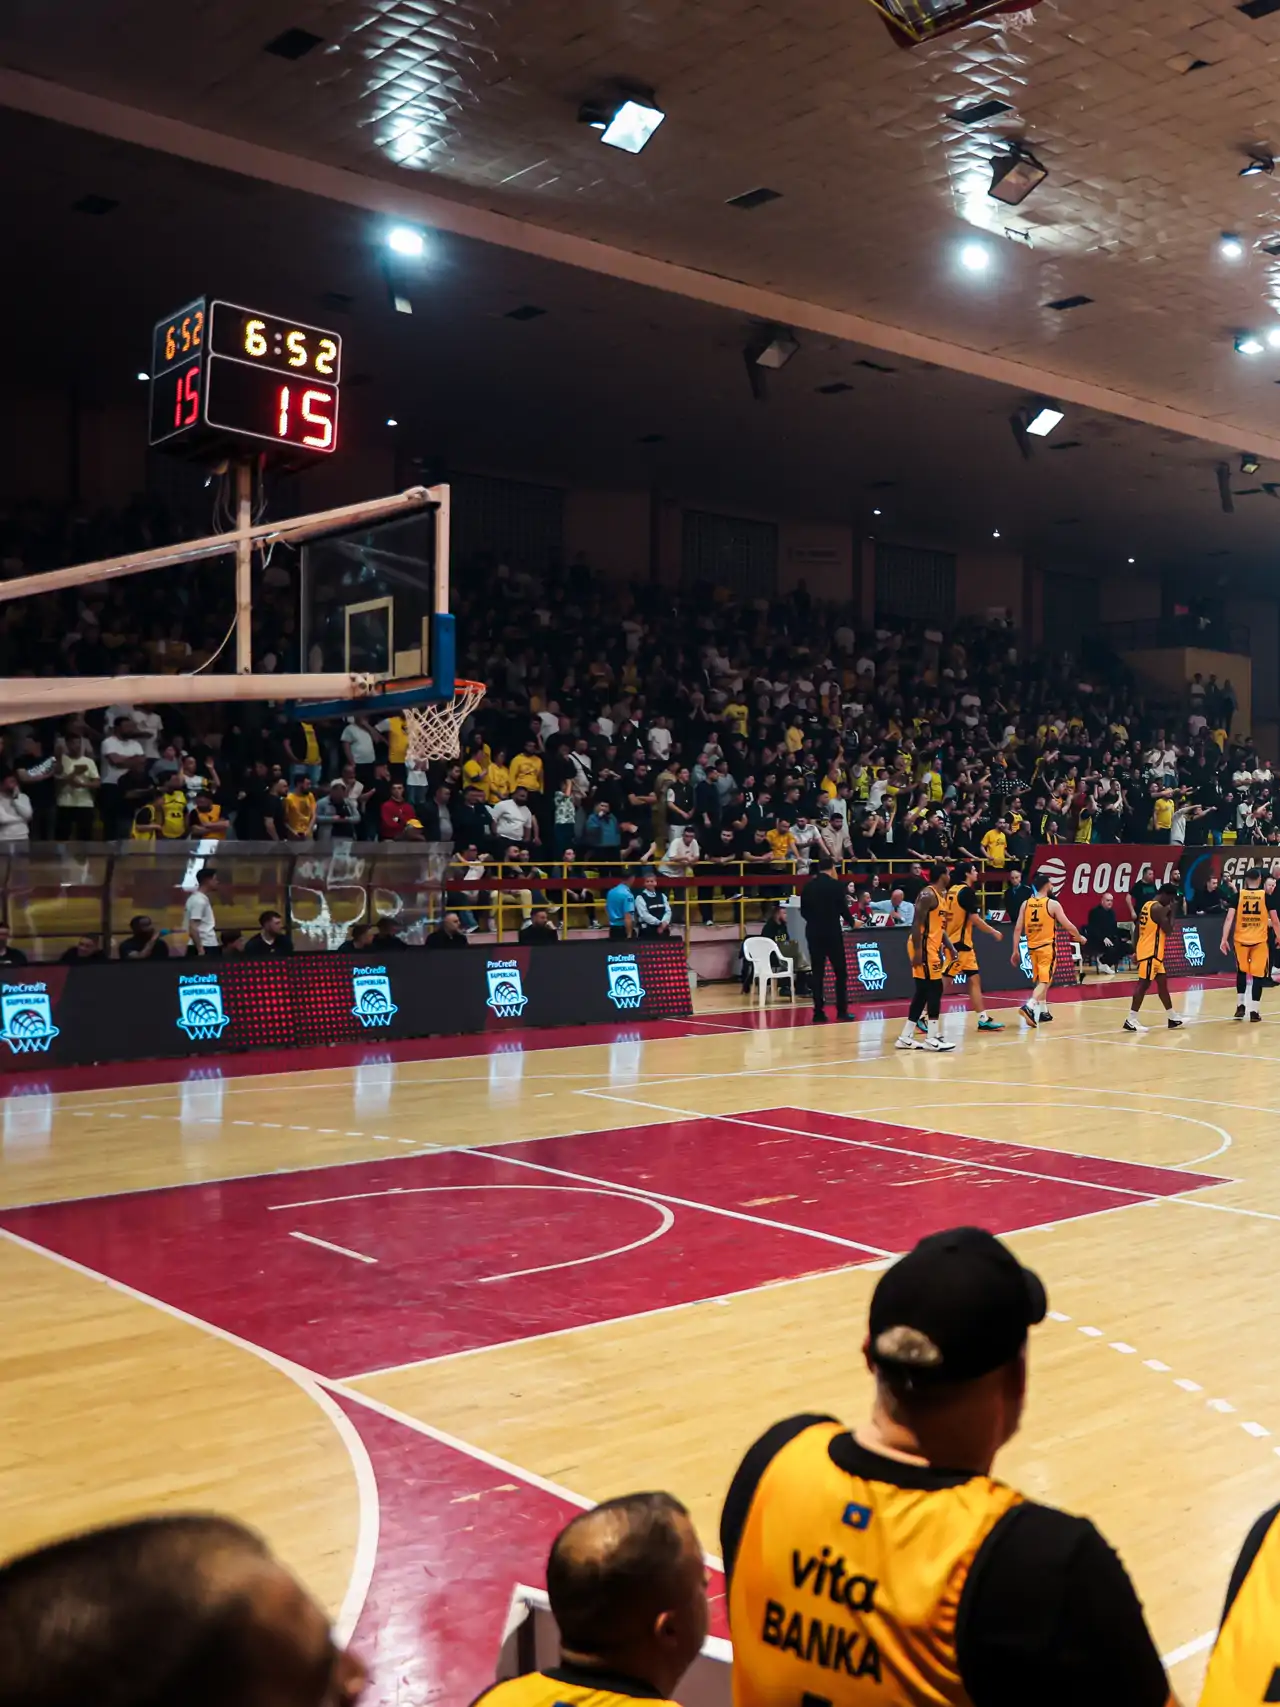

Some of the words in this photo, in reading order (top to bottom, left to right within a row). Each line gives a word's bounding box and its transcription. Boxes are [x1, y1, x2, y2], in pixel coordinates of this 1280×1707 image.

[165, 311, 203, 361] 6:52
[244, 319, 338, 375] 6:52
[174, 366, 200, 429] 15
[278, 385, 333, 448] 15
[1030, 909, 1039, 922] 1
[1242, 901, 1261, 915] 11
[2, 981, 48, 993] ProCredit
[486, 959, 518, 968] ProCredit
[791, 1546, 878, 1614] vita
[761, 1598, 884, 1685] BANKA
